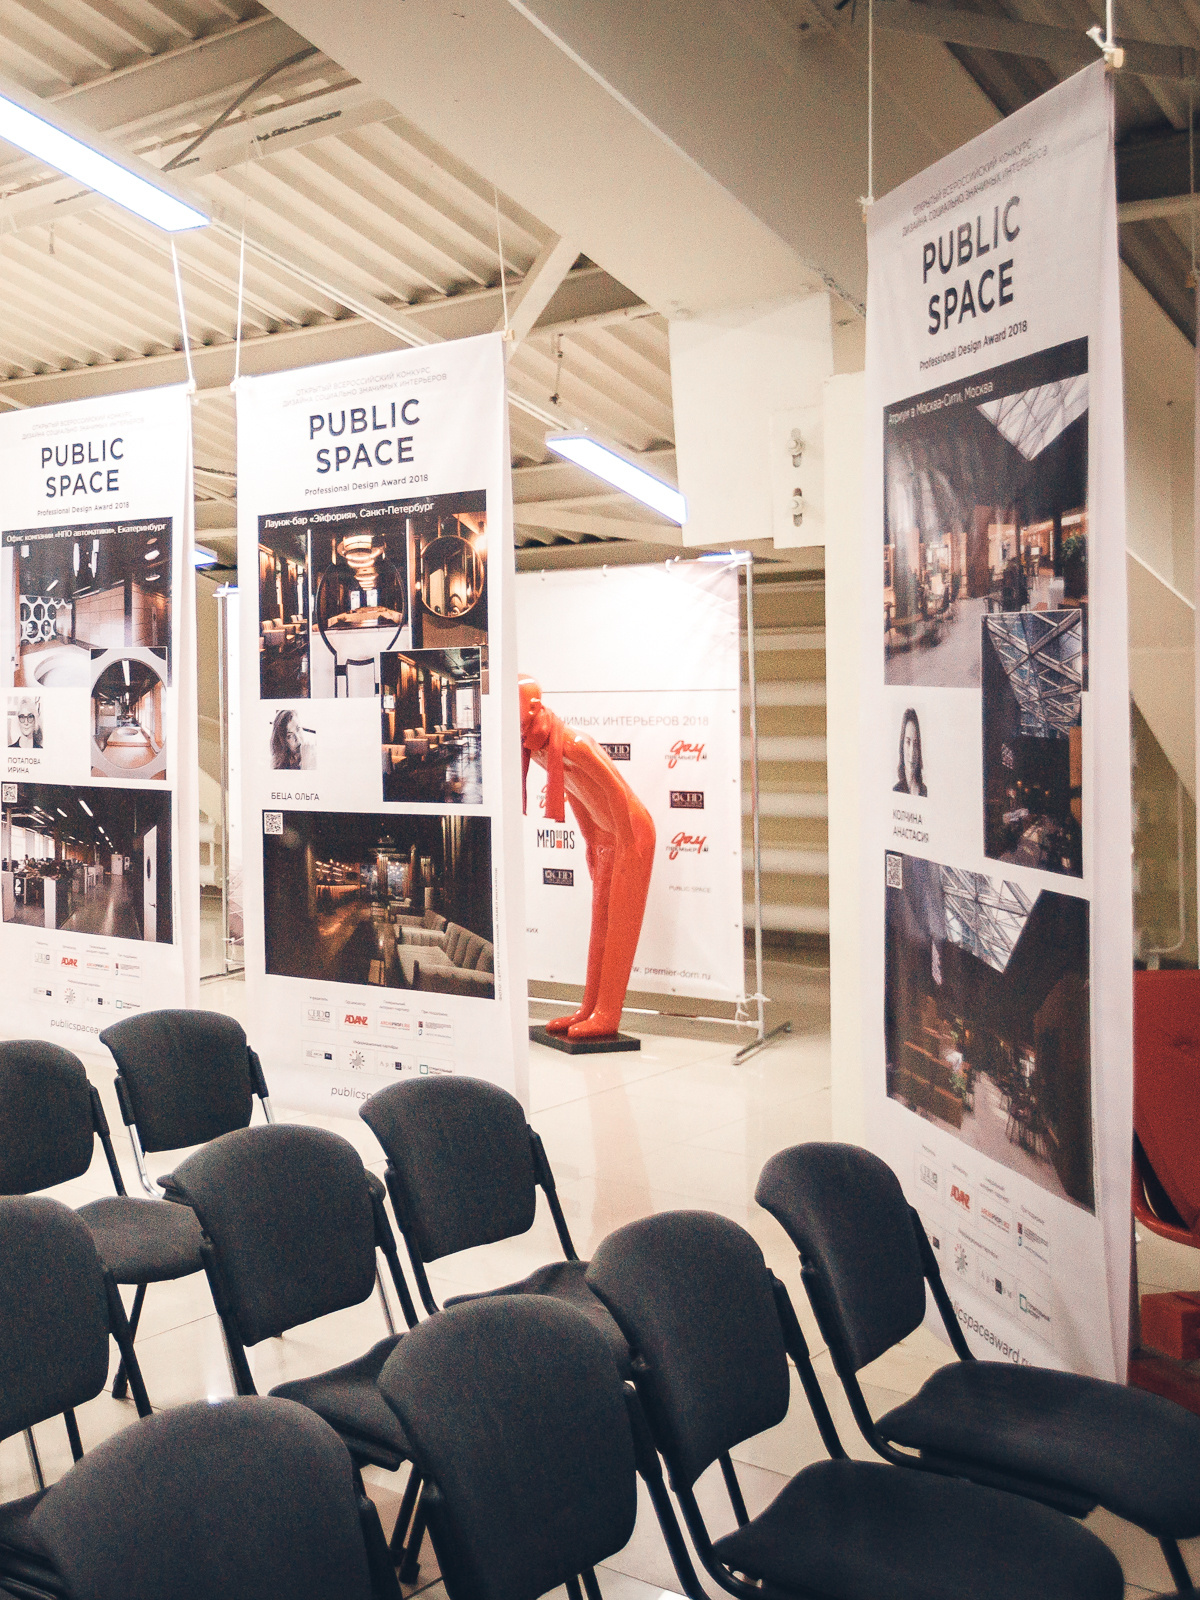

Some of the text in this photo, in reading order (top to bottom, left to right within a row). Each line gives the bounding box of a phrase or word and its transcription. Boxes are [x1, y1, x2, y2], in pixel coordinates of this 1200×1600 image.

[922, 196, 1020, 284] PUBLIC
[928, 259, 1014, 336] SPACE
[920, 320, 1028, 372] Professional Design Award 2018
[964, 382, 993, 399] Москва
[309, 399, 420, 440] PUBLIC
[41, 438, 124, 469] PUBLIC
[316, 436, 414, 474] SPACE
[46, 469, 119, 498] SPACE
[305, 474, 428, 496] Professional Design Award 2018
[37, 508, 70, 516] Professional
[264, 502, 435, 528] Лаунж-бар «Эйфория», Санкт-Петербург
[7, 535, 23, 543] Офис
[118, 523, 167, 533] Екатеринбург
[603, 716, 679, 726] ИНТЕРЬЕРОВ
[683, 716, 708, 726] 2018
[271, 792, 319, 801] БЕЦА ОЛЬГА
[51, 1019, 102, 1034] publicspacea
